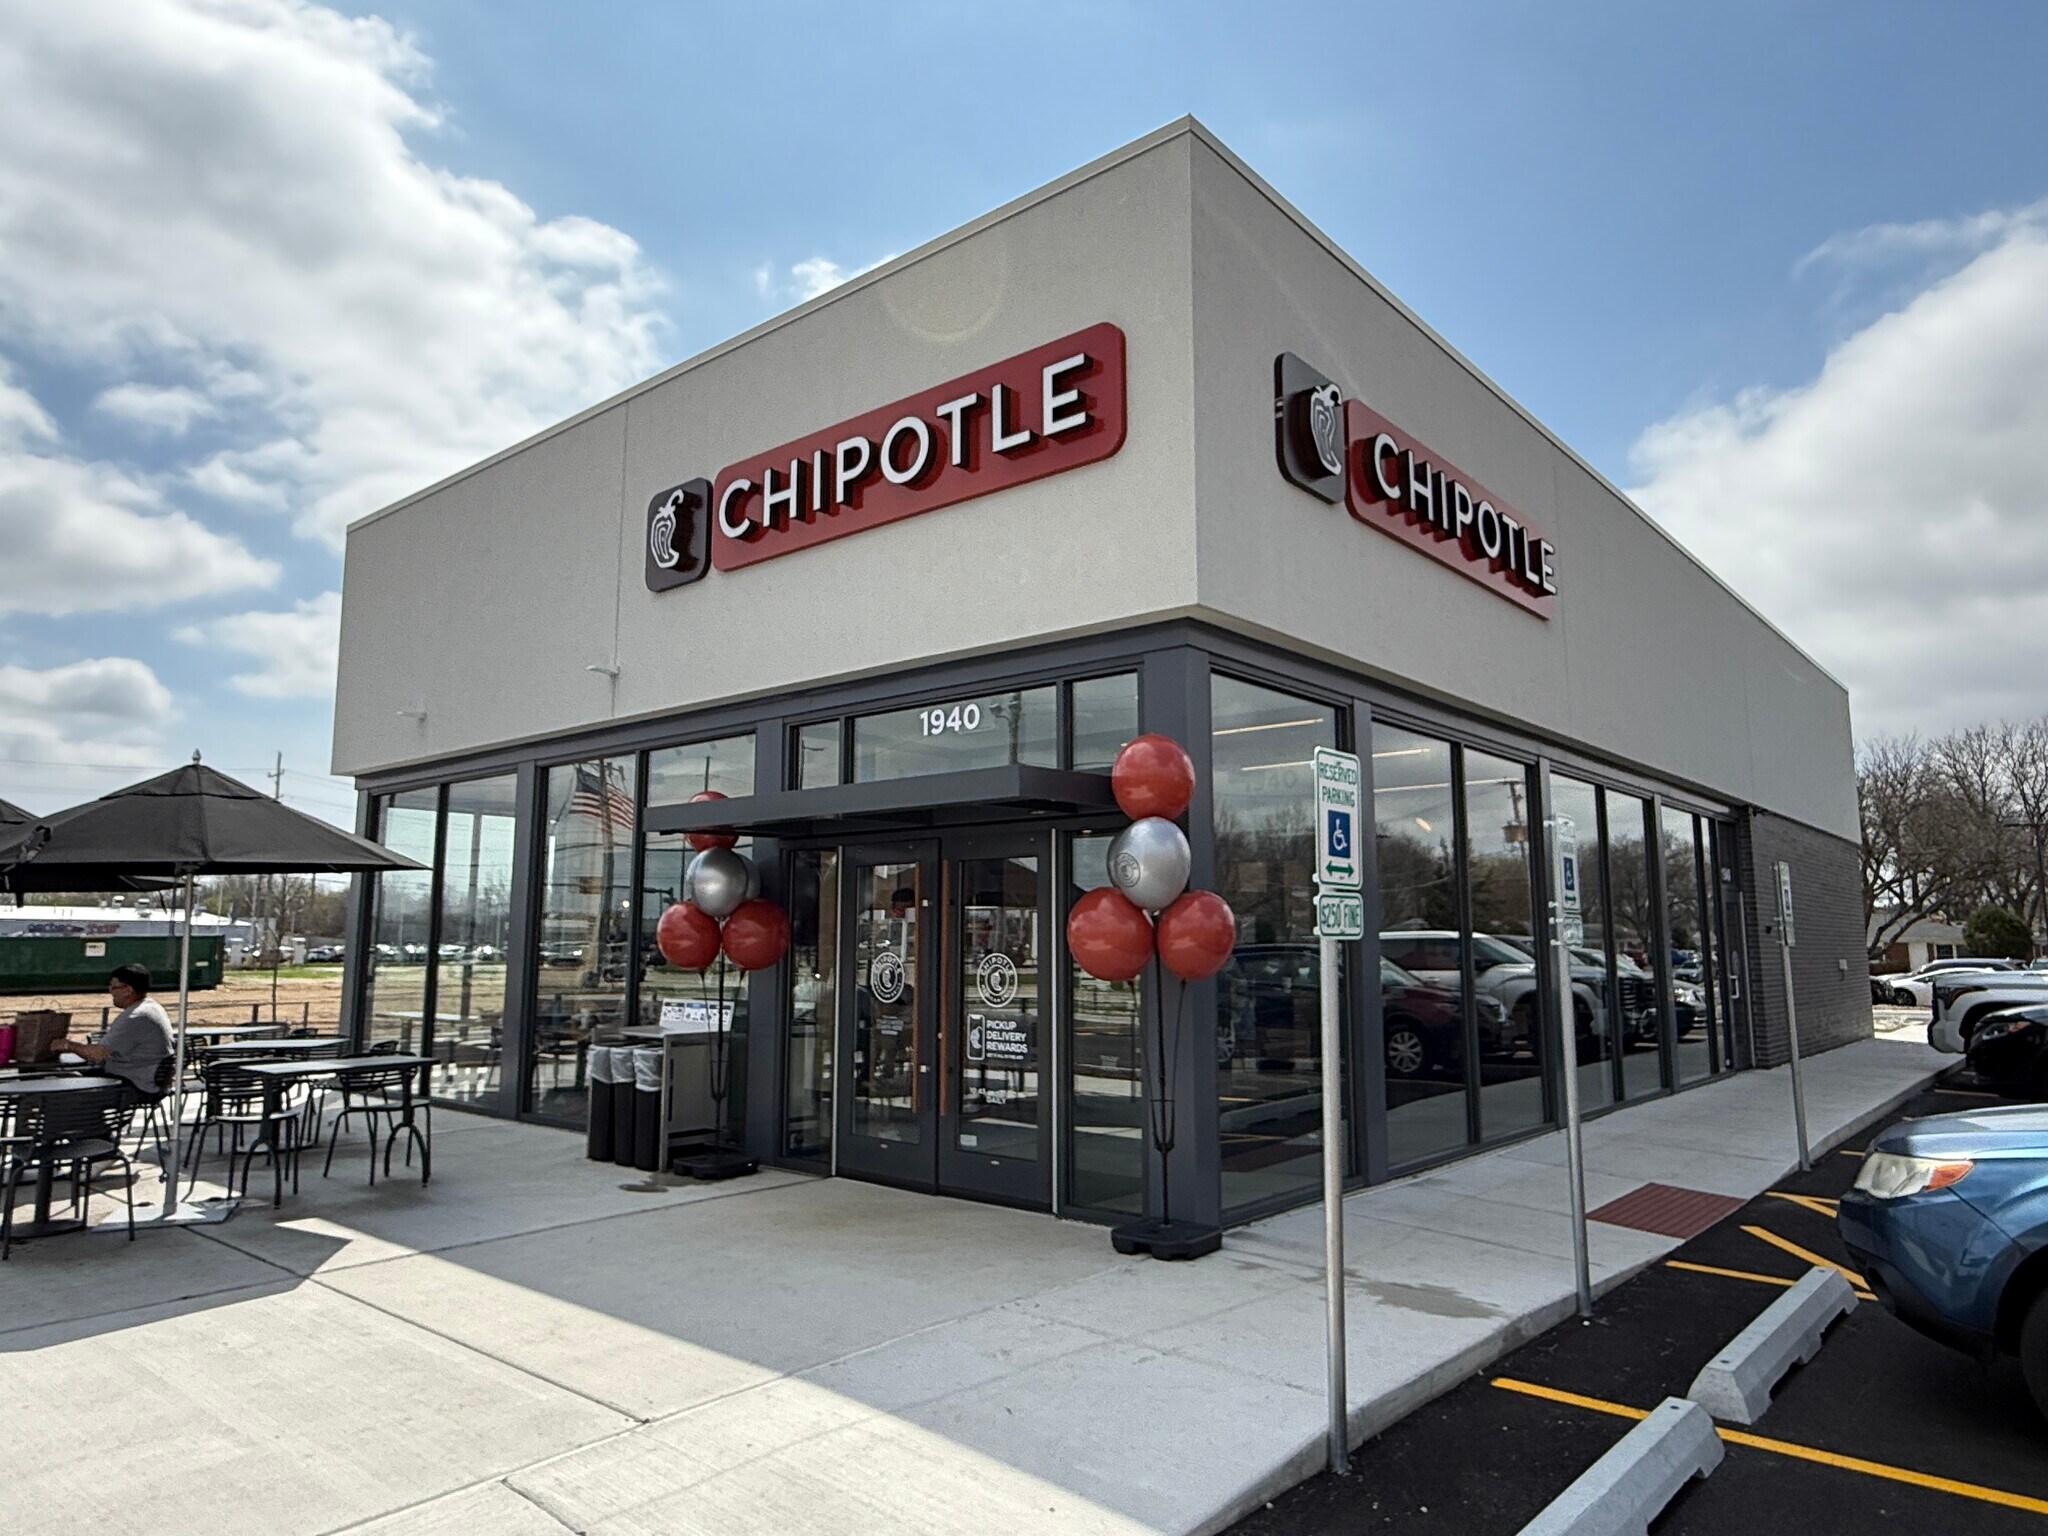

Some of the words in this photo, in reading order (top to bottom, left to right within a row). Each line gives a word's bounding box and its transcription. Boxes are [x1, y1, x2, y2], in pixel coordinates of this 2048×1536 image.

[718, 352, 1087, 539] CHIPOTLE
[1374, 432, 1557, 595] CHIPOTLE
[919, 703, 981, 736] 1940
[1319, 762, 1357, 785] RESERVED
[1321, 785, 1356, 807] PARKING
[1320, 902, 1341, 928] $250
[1343, 903, 1361, 928] FINE
[980, 956, 1014, 976] CHIPOTLE
[986, 1019, 1018, 1030] PICKUP
[986, 1030, 1027, 1042] DELIVERY
[986, 1041, 1028, 1054] REWARDS
